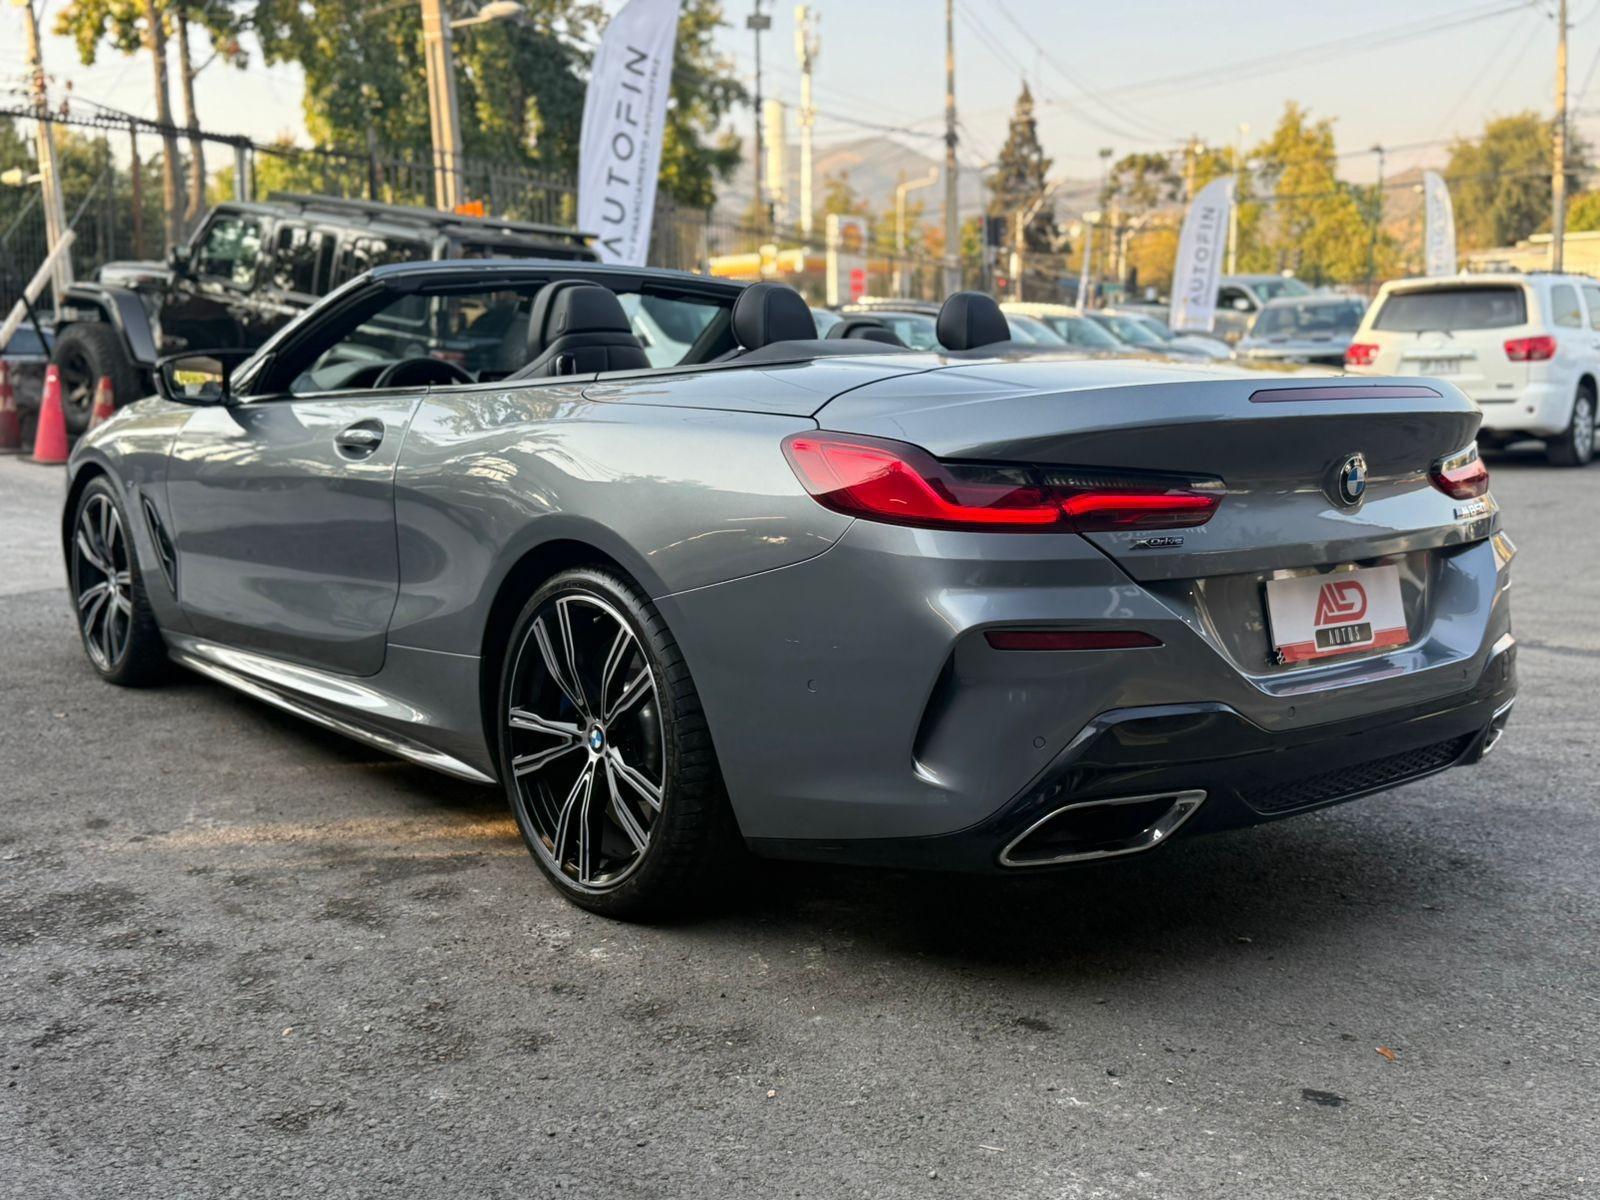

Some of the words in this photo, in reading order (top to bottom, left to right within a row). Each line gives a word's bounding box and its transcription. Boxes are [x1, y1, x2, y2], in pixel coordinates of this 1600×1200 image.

[601, 45, 650, 258] AUTOFIN
[1190, 206, 1216, 306] AUTOFIN
[1328, 625, 1361, 645] AUTOS
